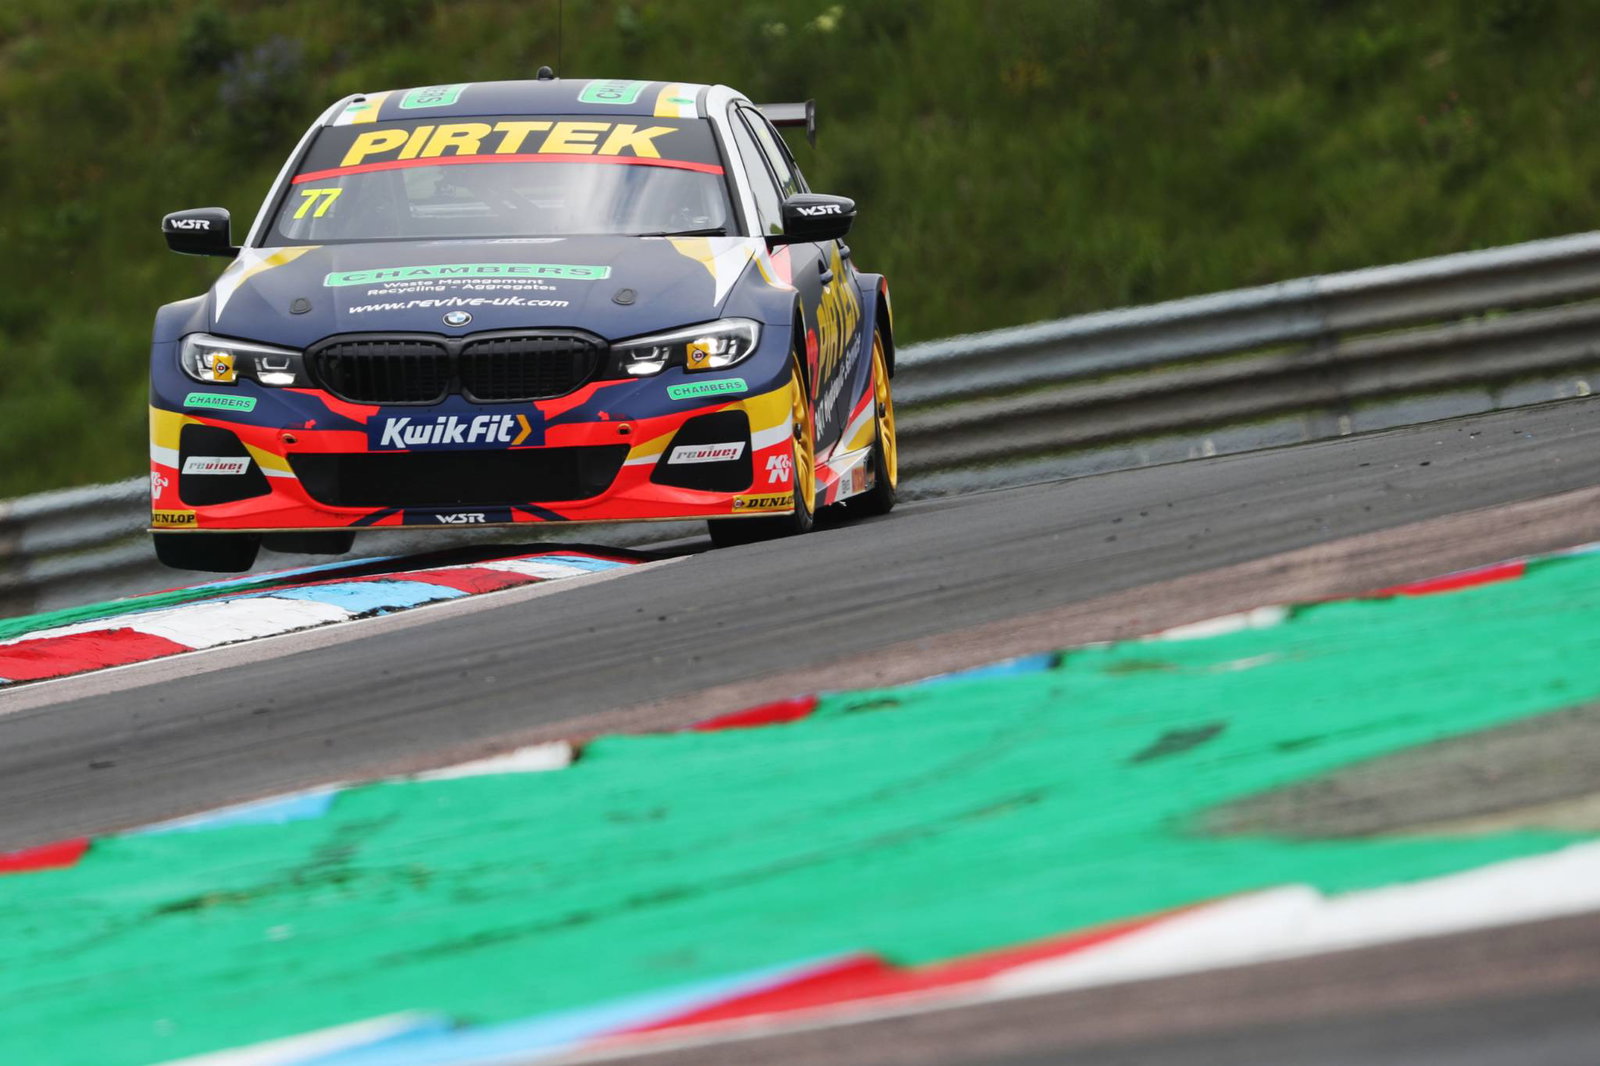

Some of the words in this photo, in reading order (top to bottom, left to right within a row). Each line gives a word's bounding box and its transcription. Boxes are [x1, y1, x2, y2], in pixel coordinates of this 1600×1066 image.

[339, 120, 679, 168] PIRTEK
[293, 188, 343, 219] 77
[796, 204, 842, 216] WSR
[170, 219, 210, 230] WSR
[342, 266, 593, 282] CHAMBERS
[367, 285, 446, 296] Recycling
[462, 283, 557, 291] Aggregates
[384, 280, 434, 288] Waste
[349, 296, 569, 314] www.revive-uk.com
[673, 382, 742, 396] CHAMBERS
[188, 396, 251, 408] CHAMBERS
[152, 513, 195, 523] UNLOP
[435, 513, 486, 524] WSR
